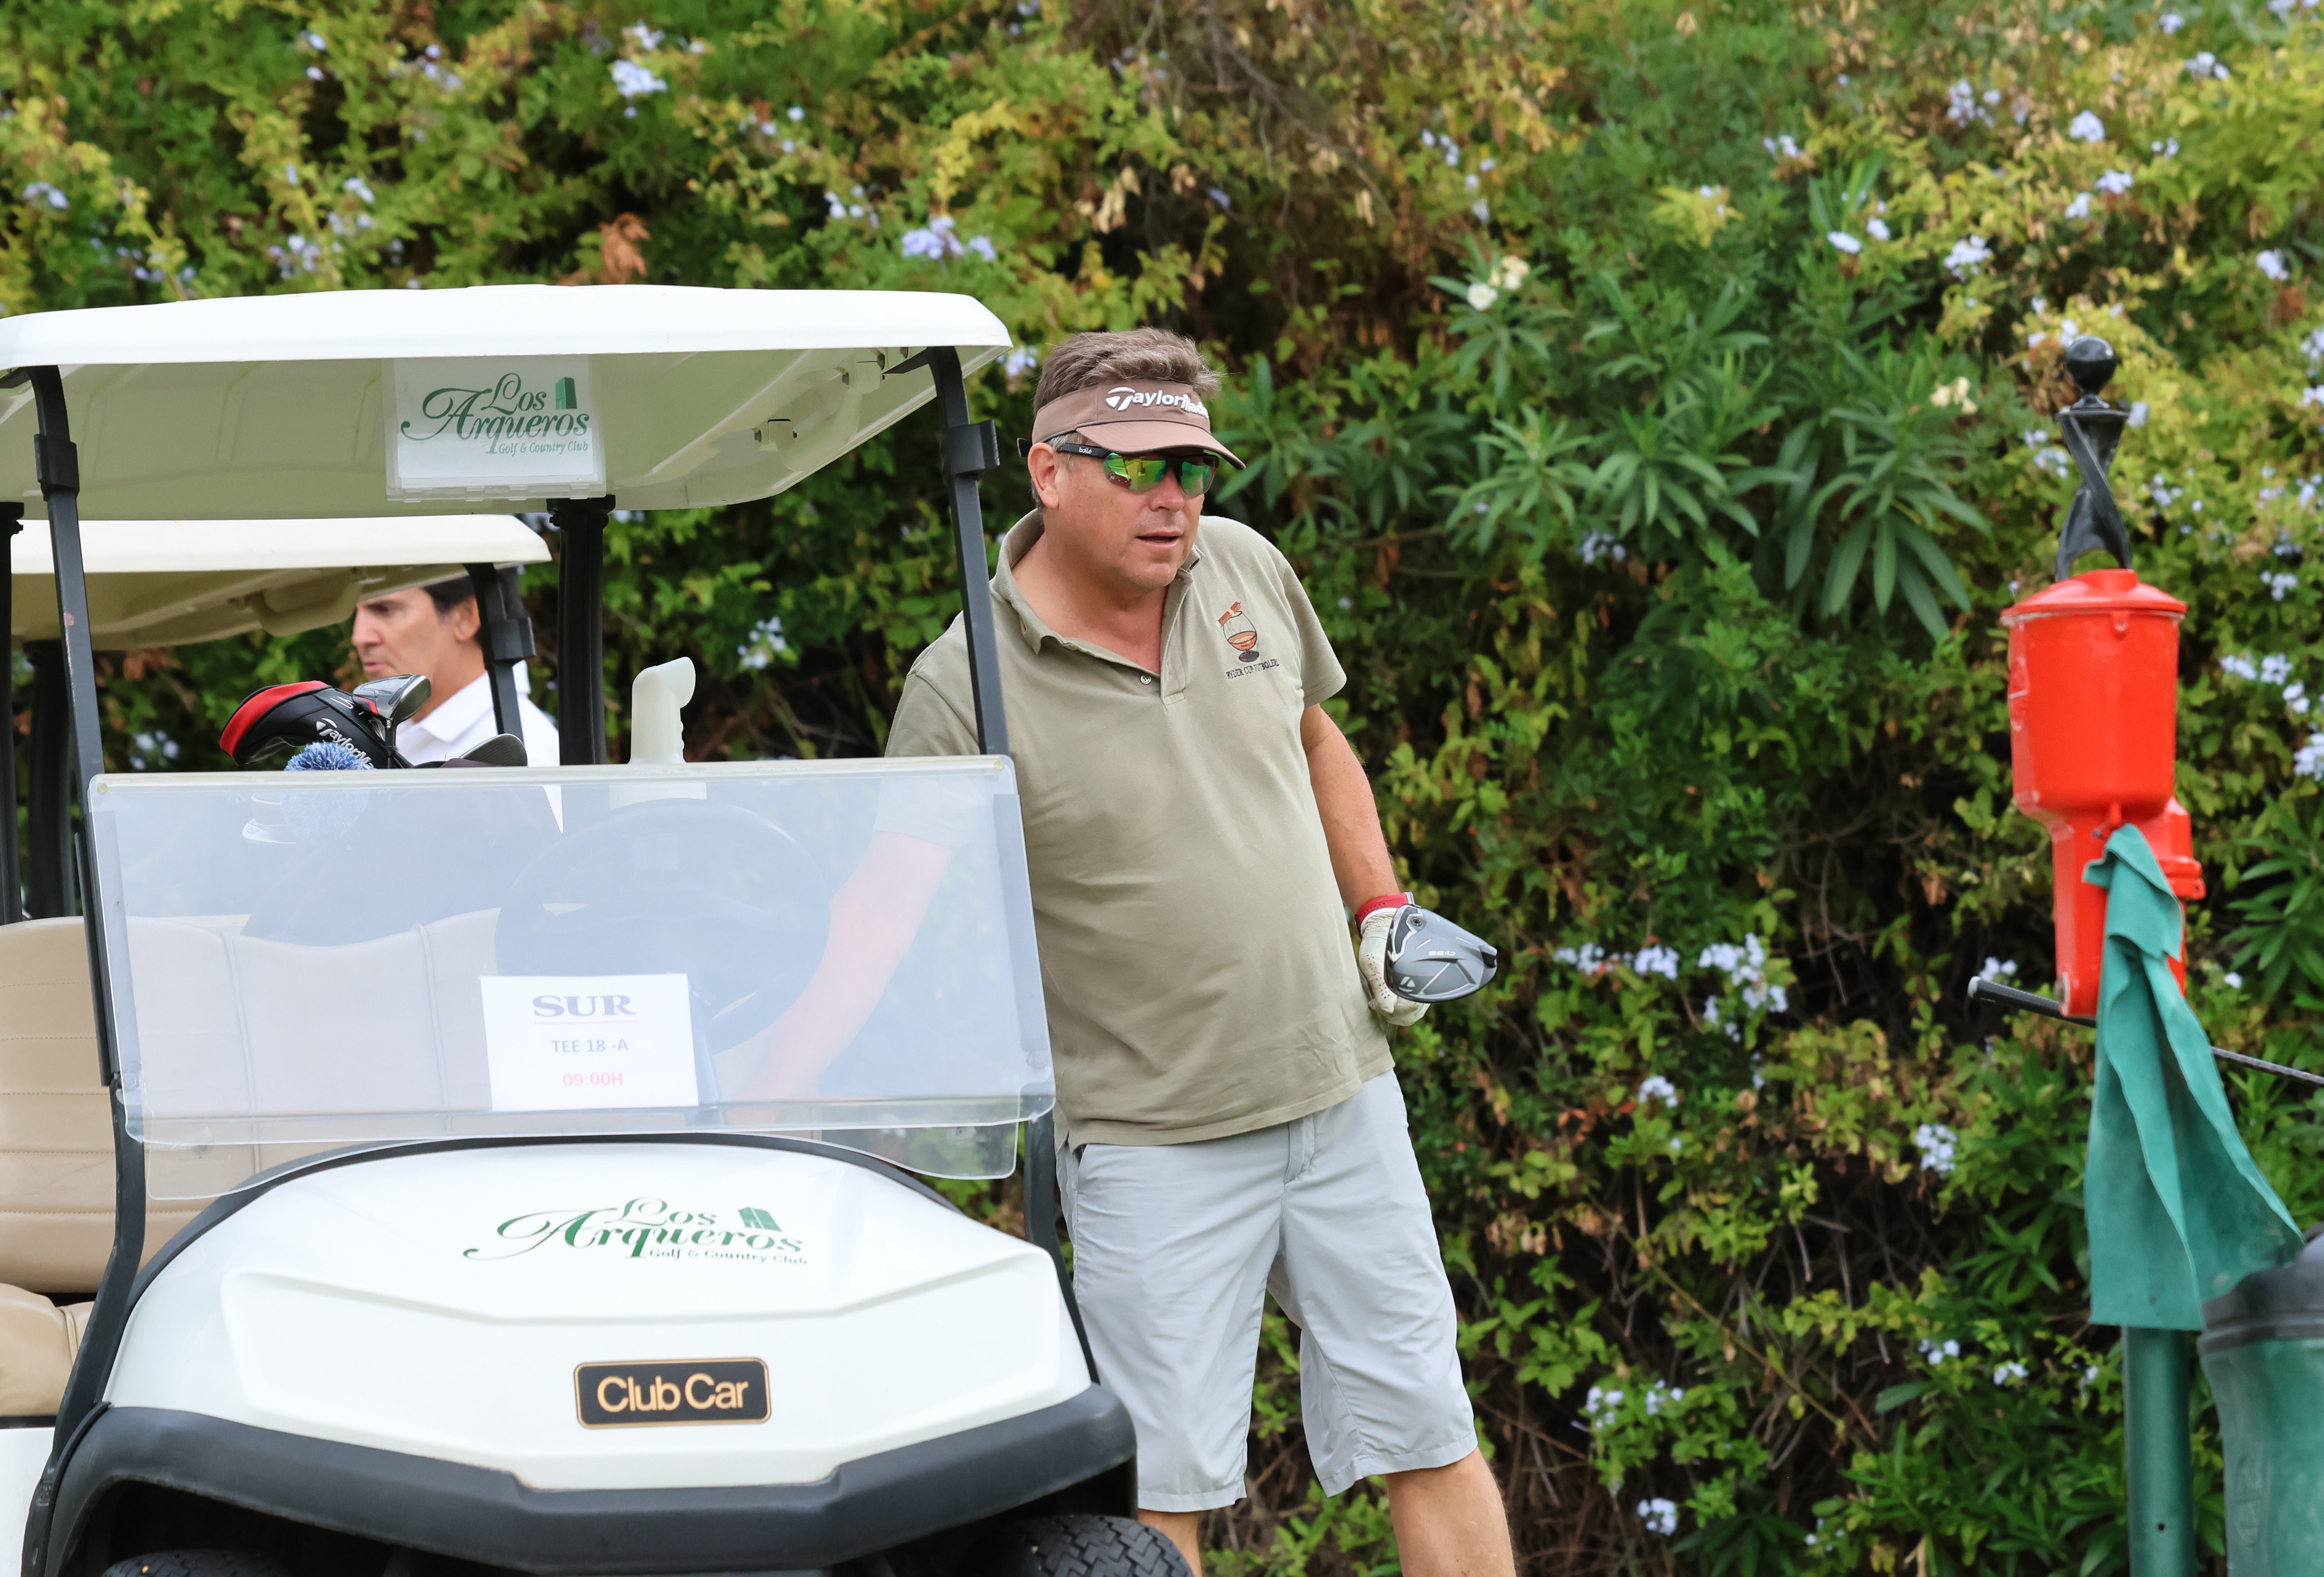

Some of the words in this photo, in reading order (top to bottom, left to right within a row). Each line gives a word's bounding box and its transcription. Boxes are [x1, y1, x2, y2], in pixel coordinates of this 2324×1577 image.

[481, 373, 546, 415] Los
[400, 388, 590, 454] Arqueros
[499, 443, 518, 456] Golf
[520, 443, 527, 453] &
[530, 442, 565, 455] Country
[568, 440, 588, 452] Club
[532, 995, 636, 1017] SUR
[551, 1039, 580, 1053] TEE
[587, 1039, 605, 1052] 18
[563, 1072, 623, 1087] 09:00H
[604, 1197, 717, 1226] Los
[463, 1207, 803, 1261] Arqueros
[649, 1248, 682, 1260] Golf
[688, 1249, 698, 1257] &
[704, 1250, 766, 1262] Country
[773, 1255, 807, 1265] Club
[597, 1375, 682, 1413] Club
[685, 1372, 749, 1410] Car
